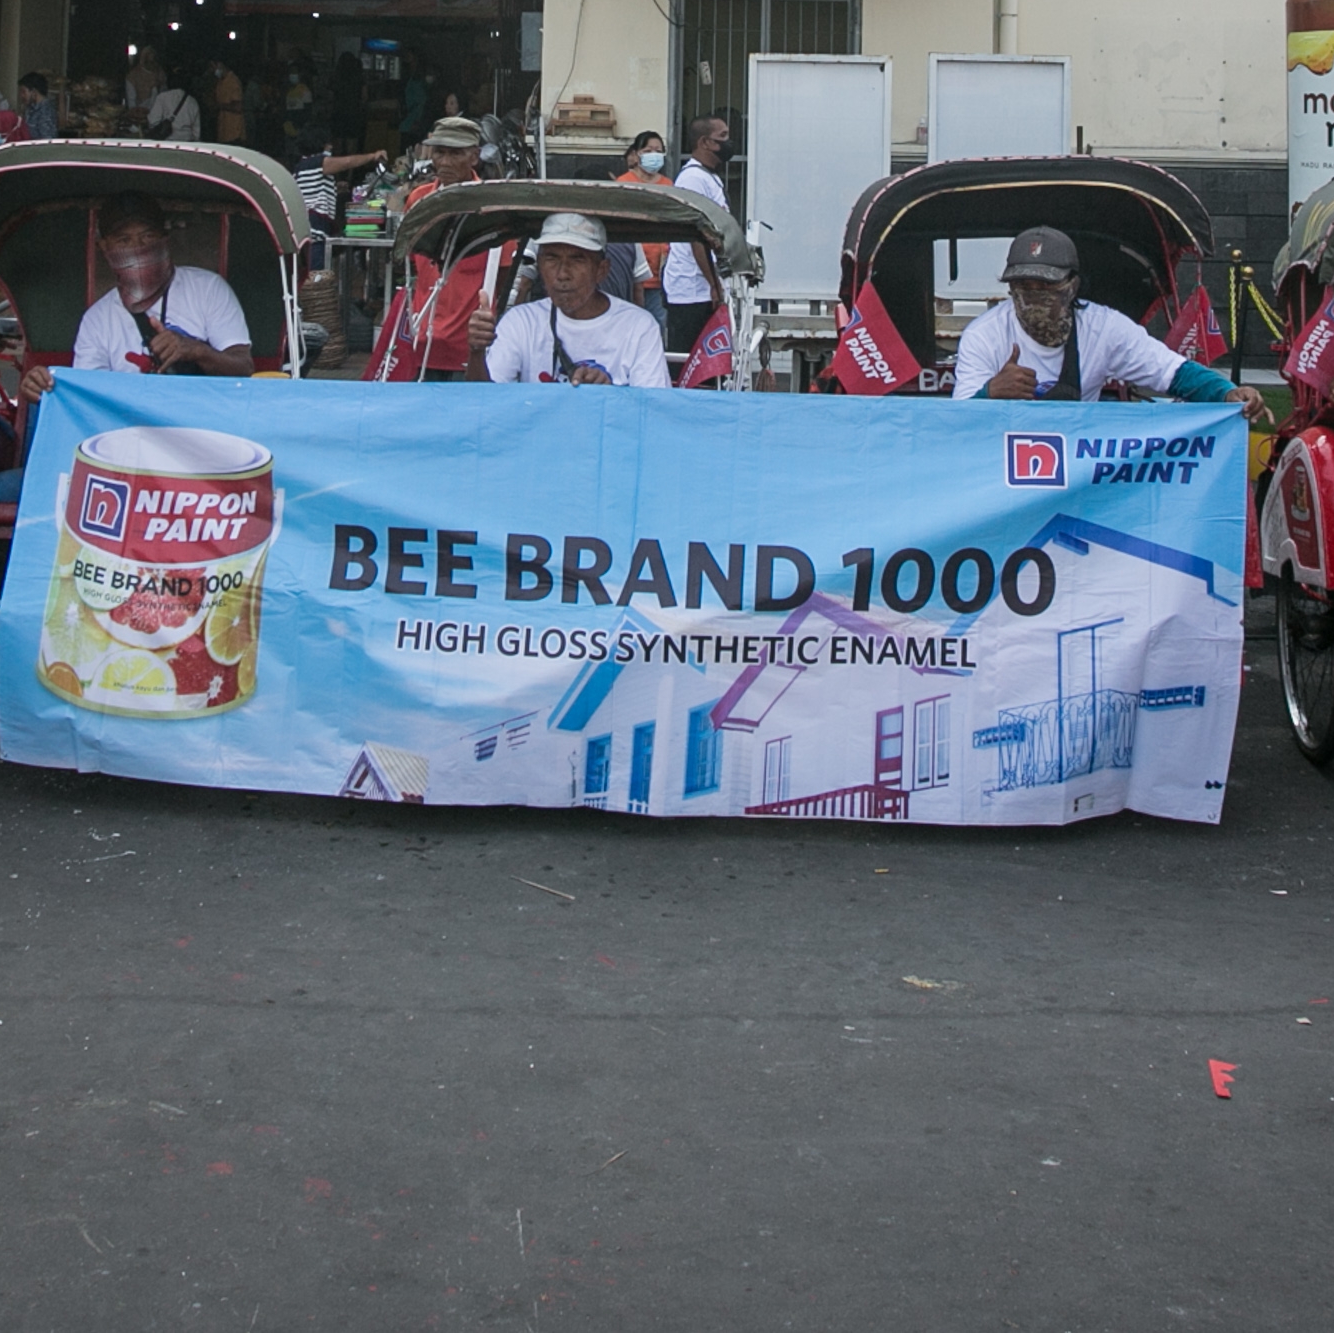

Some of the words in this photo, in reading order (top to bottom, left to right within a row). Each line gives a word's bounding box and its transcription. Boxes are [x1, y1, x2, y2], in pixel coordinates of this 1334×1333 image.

[845, 337, 879, 379] PAINT
[854, 327, 897, 384] NIPPON
[1075, 436, 1216, 461] NIPPON
[1092, 461, 1199, 485] PAINT
[134, 490, 257, 515] NIPPON
[144, 518, 247, 542] PAINT
[73, 560, 107, 585] BEE
[111, 571, 193, 597] BRAND
[198, 571, 244, 596] 1000
[329, 524, 478, 600] BEE
[505, 532, 816, 612] BRAND
[843, 546, 1056, 616] 1000
[397, 620, 486, 655] HIGH
[496, 626, 609, 662] GLOSS
[615, 632, 819, 666] SYNTHETIC
[830, 637, 977, 669] ENAMEL
